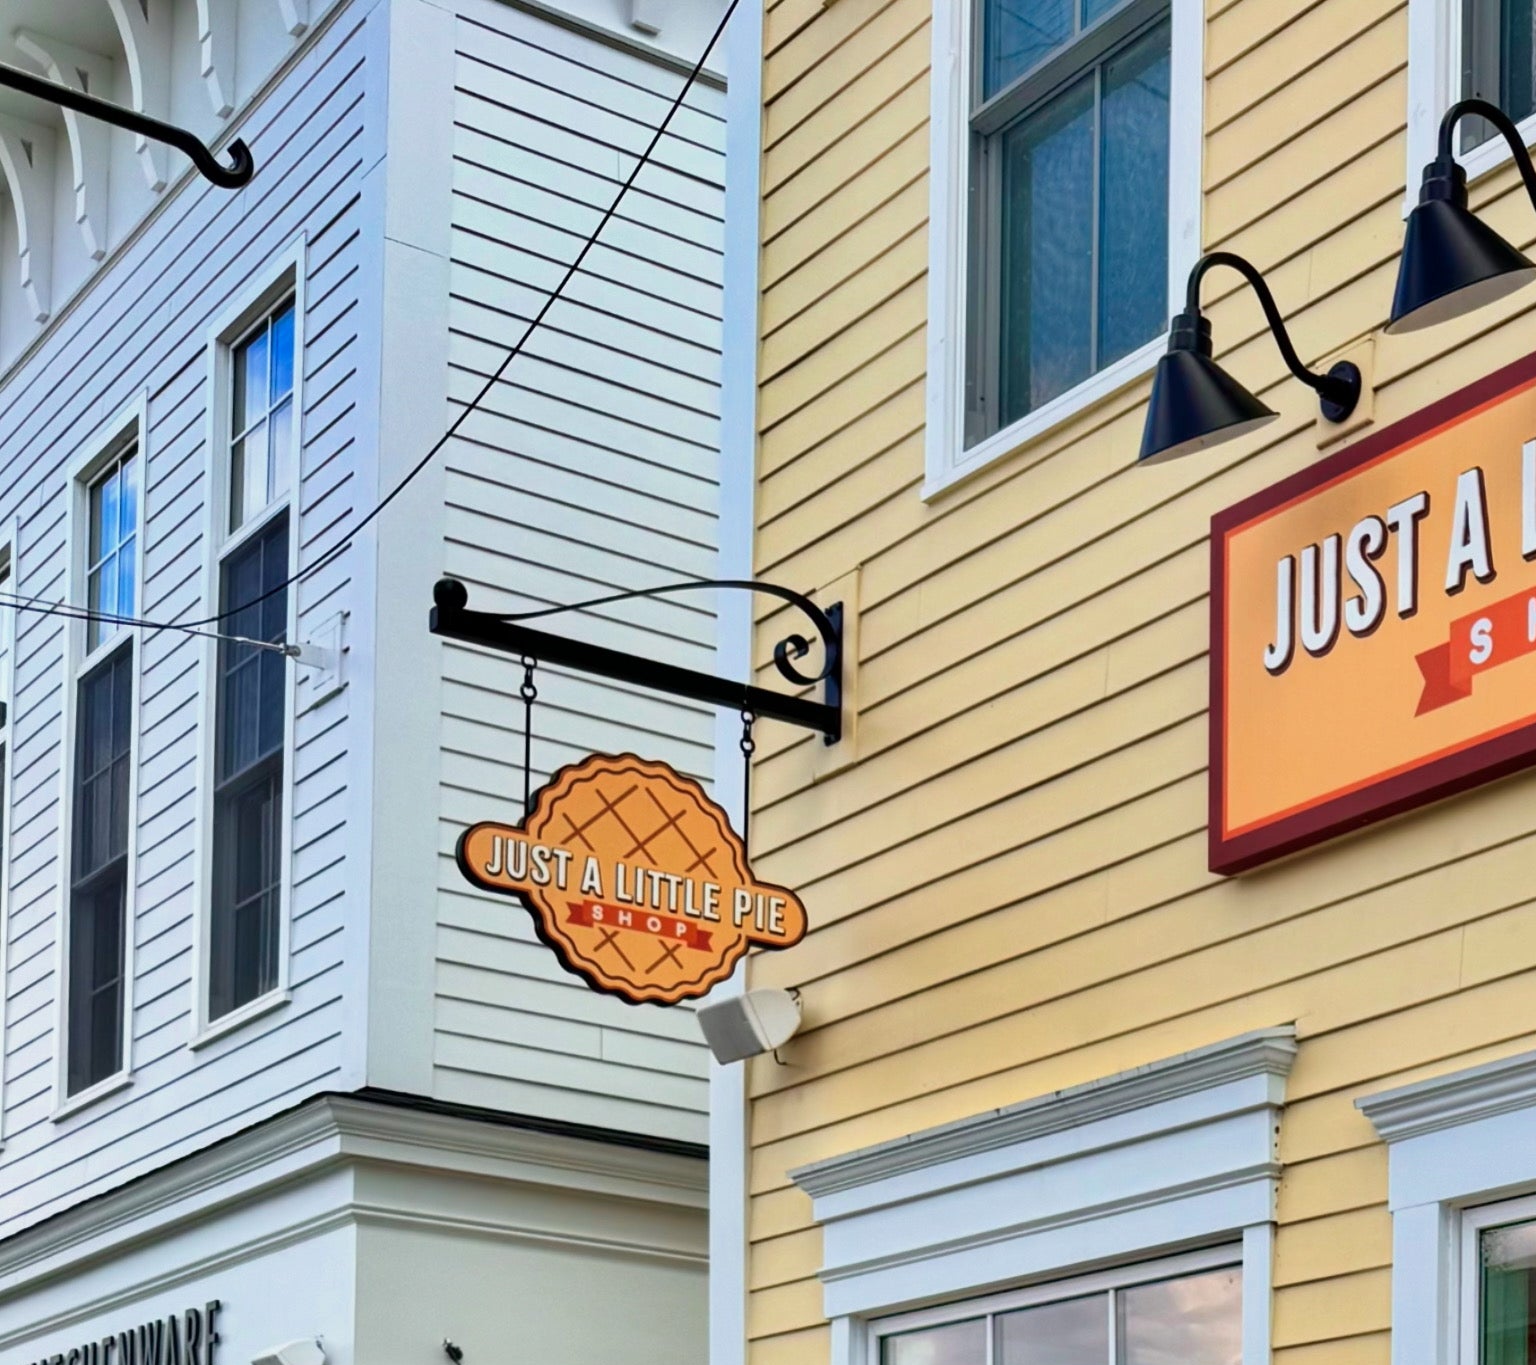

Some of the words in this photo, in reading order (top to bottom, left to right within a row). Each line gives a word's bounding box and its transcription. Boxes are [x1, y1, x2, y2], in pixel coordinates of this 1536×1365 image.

[1263, 491, 1430, 676] JUST
[1445, 466, 1496, 596] A
[486, 836, 573, 889] JUST
[581, 857, 604, 897] A
[616, 863, 720, 921] LITTLE
[733, 889, 786, 935] PIE
[591, 906, 688, 937] SHOP
